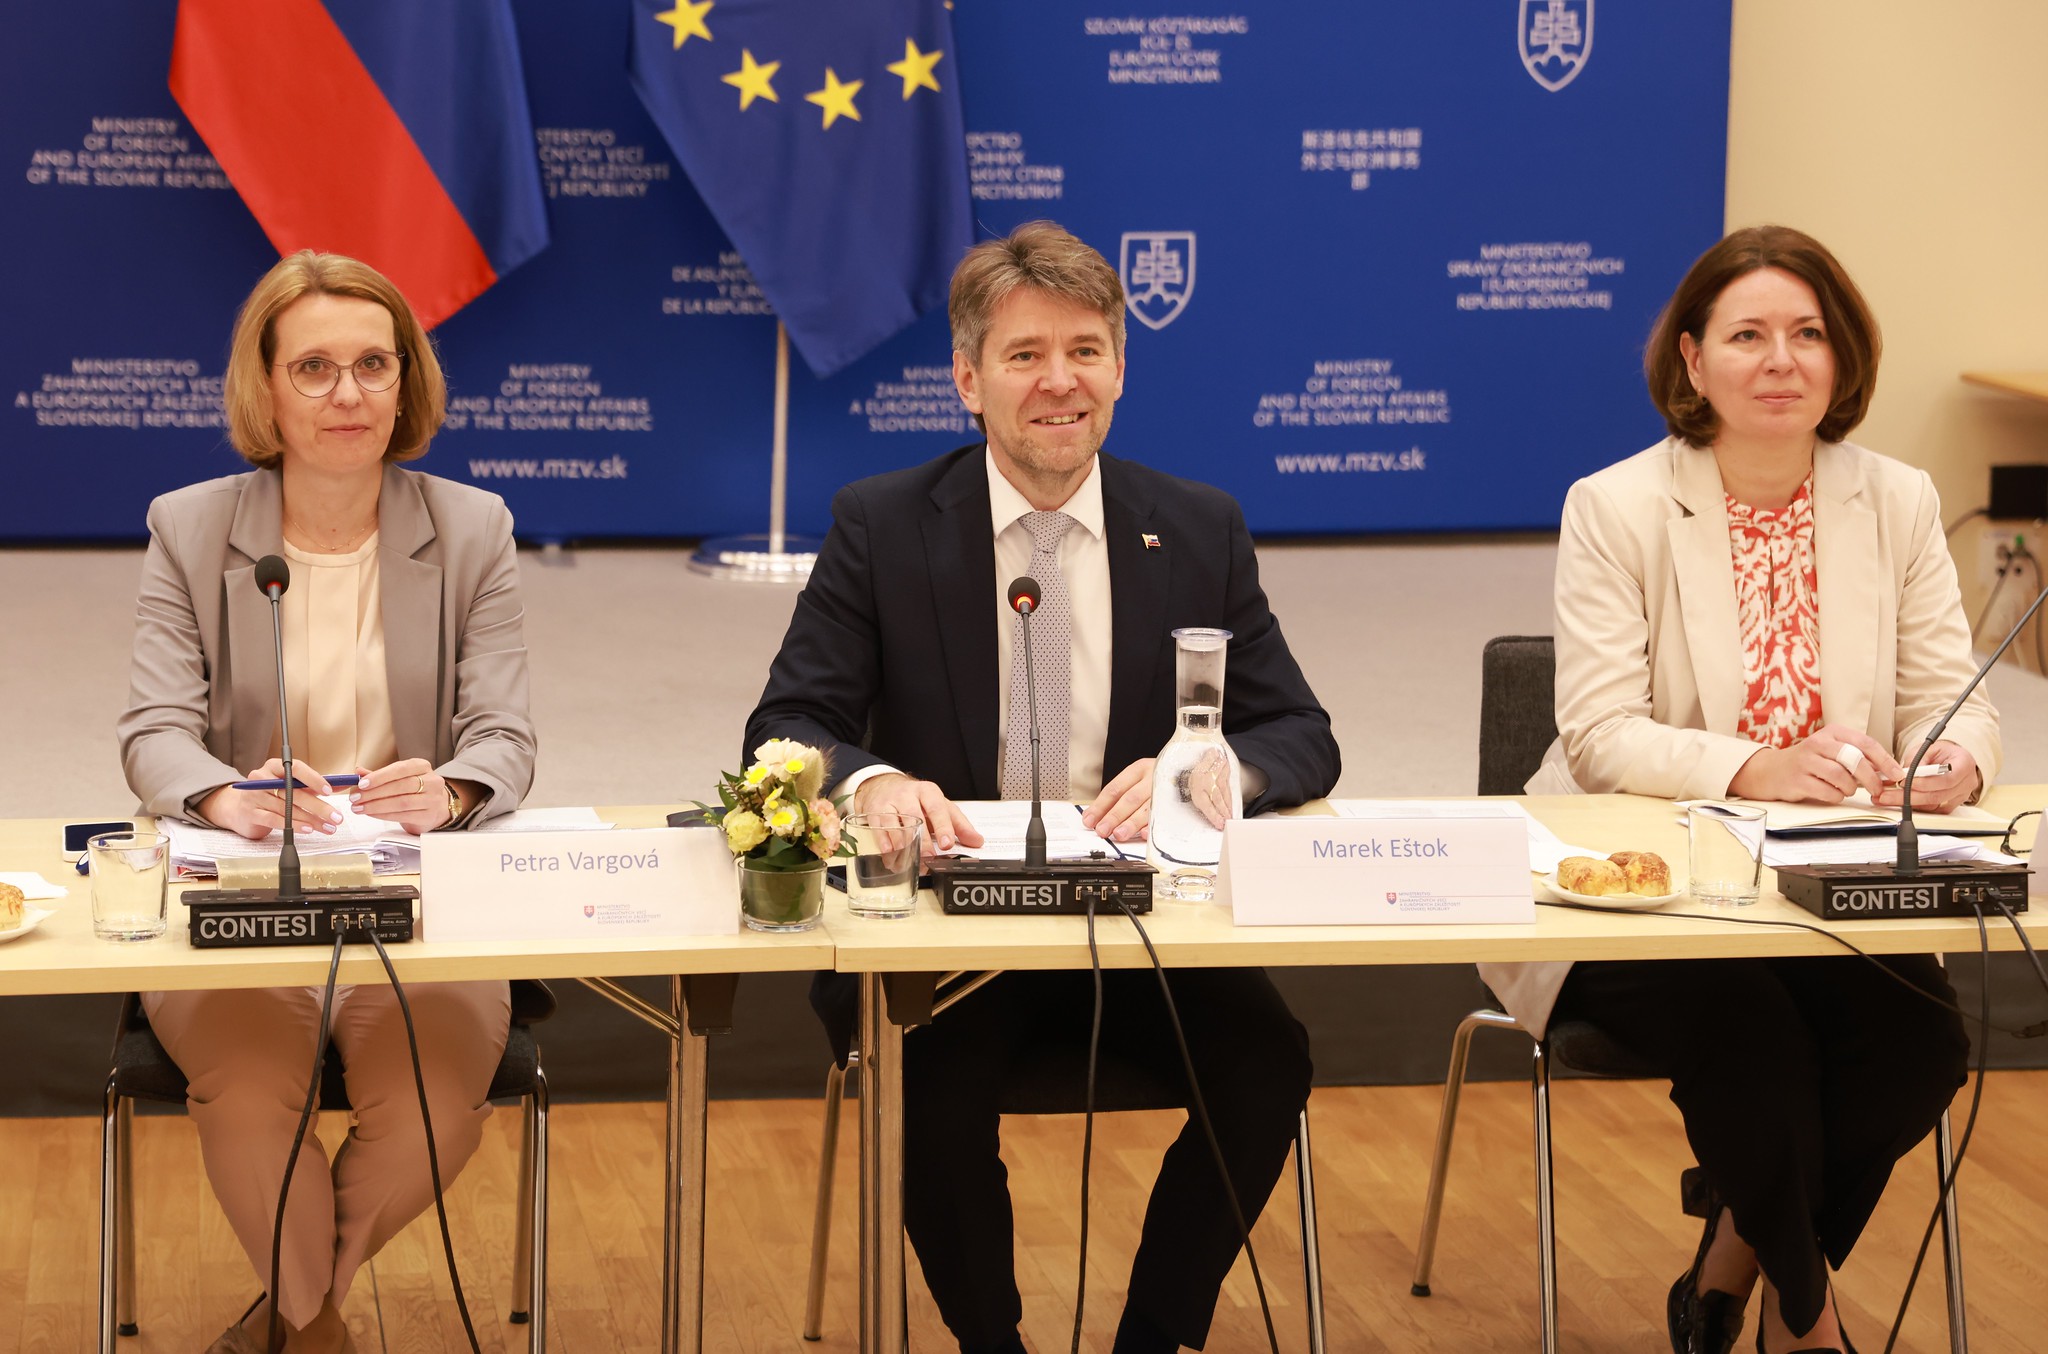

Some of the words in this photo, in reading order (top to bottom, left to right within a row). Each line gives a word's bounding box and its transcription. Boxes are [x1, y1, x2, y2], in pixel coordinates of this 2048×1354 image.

[92, 117, 178, 135] MINISTRY
[84, 133, 107, 150] OF
[112, 135, 188, 152] FOREIGN
[32, 150, 75, 168] AND
[77, 151, 172, 169] EUROPEAN
[27, 166, 50, 184] OF
[56, 168, 89, 185] THE
[94, 170, 159, 187] SLOVAK
[672, 266, 690, 282] DE
[717, 284, 728, 297] Y
[662, 298, 681, 314] DE
[684, 298, 702, 314] LA
[71, 358, 200, 377] MINISTERSTVO
[509, 363, 592, 380] MINISTRY
[1314, 359, 1393, 376] MINISTRY
[500, 380, 522, 396] OF
[527, 380, 601, 397] FOREIGN
[1305, 376, 1328, 393] OF
[1331, 375, 1402, 393] FOREIGN
[15, 391, 29, 408] A
[450, 397, 490, 413] AND
[494, 397, 583, 413] EUROPEAN
[587, 397, 649, 413] AFFAIRS
[849, 400, 862, 415] A
[1258, 393, 1297, 410] AND
[1299, 392, 1386, 410] EUROPEAN
[1387, 390, 1449, 407] AFFAIRS
[36, 410, 140, 430] SLOVENSKEJ
[446, 414, 467, 430] OF
[474, 414, 504, 430] THE
[509, 414, 572, 430] SLOVAK
[576, 414, 653, 431] REPUBLIC
[869, 416, 965, 433] SLOVENSKEJ
[1253, 410, 1275, 427] OF
[1281, 410, 1309, 427] THE
[1314, 409, 1373, 426] SLOVAK
[1377, 407, 1450, 424] REPUBLIC
[469, 454, 628, 479] www.mzv.sk
[1275, 446, 1427, 474] www.mzv.sk
[1313, 838, 1383, 858] Marek
[1390, 838, 1449, 858] Eštok
[500, 853, 560, 873] Petra
[567, 848, 659, 875] Vargová
[953, 880, 1069, 907] CONTEST
[1831, 883, 1945, 911] CONTEST
[200, 909, 323, 939] CONTEST
